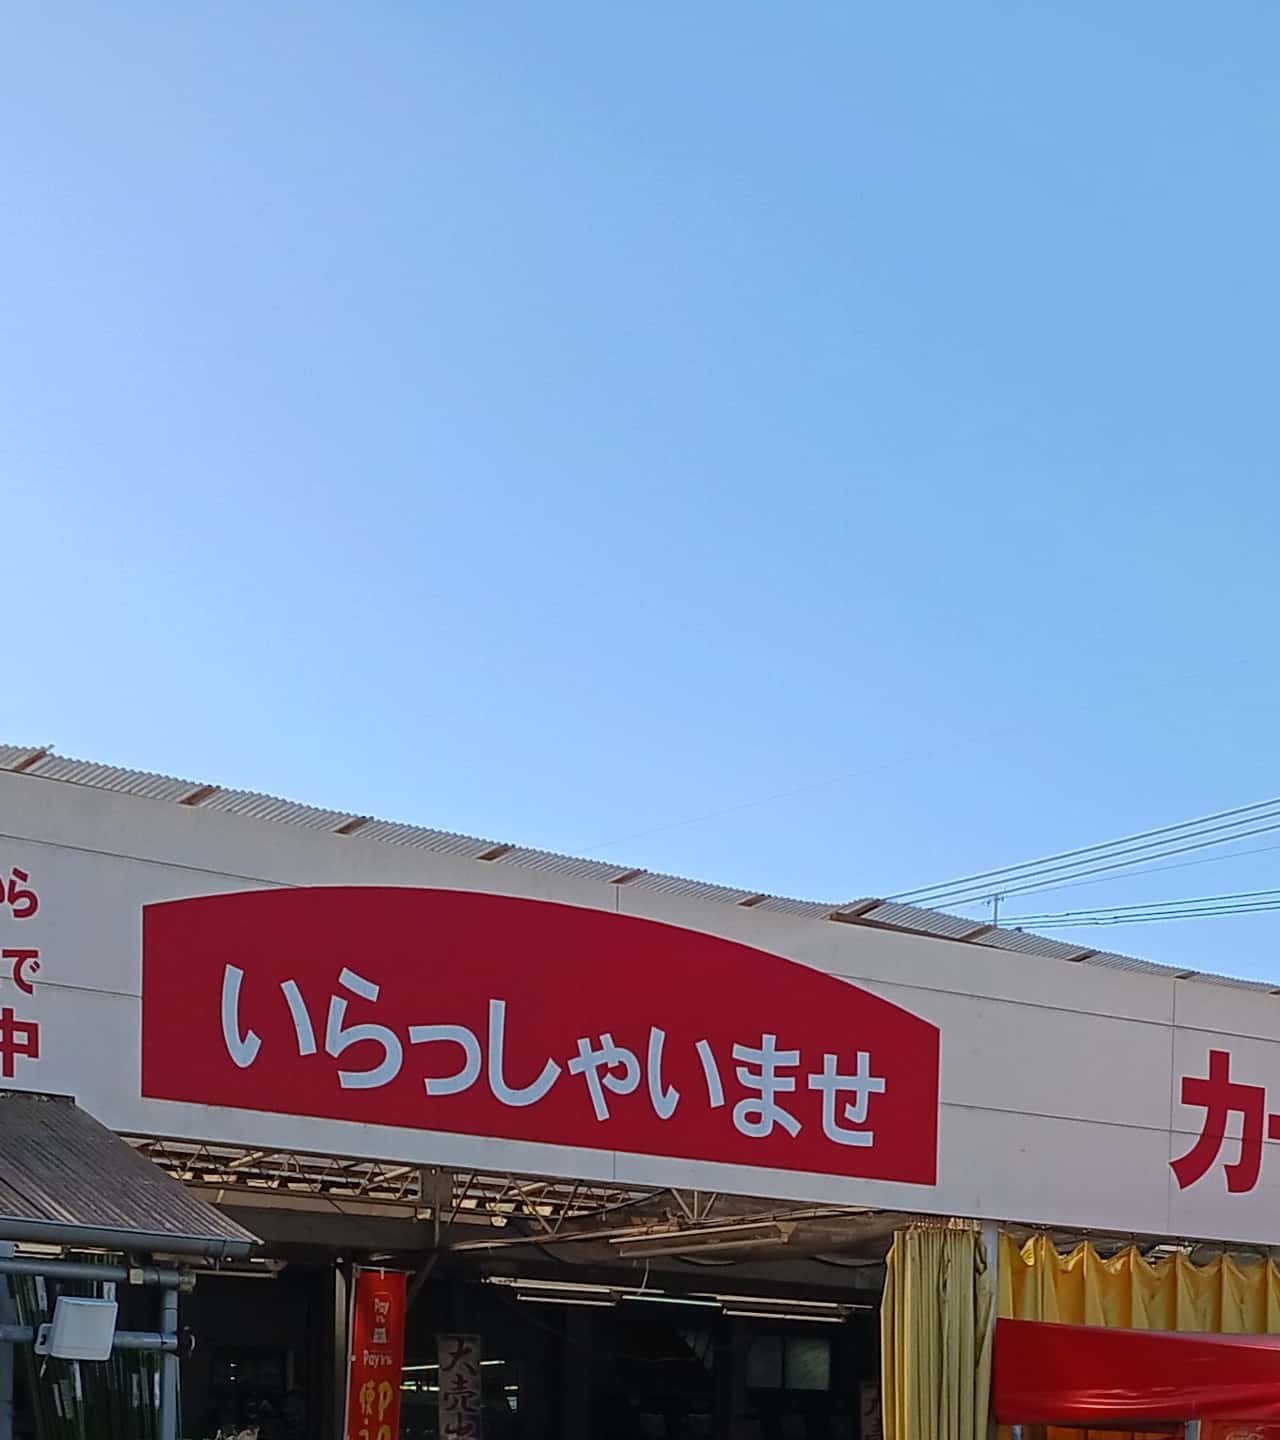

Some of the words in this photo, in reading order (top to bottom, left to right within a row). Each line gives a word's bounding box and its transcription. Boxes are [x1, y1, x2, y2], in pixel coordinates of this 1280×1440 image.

[220, 963, 886, 1148] いらっしゃいませ
